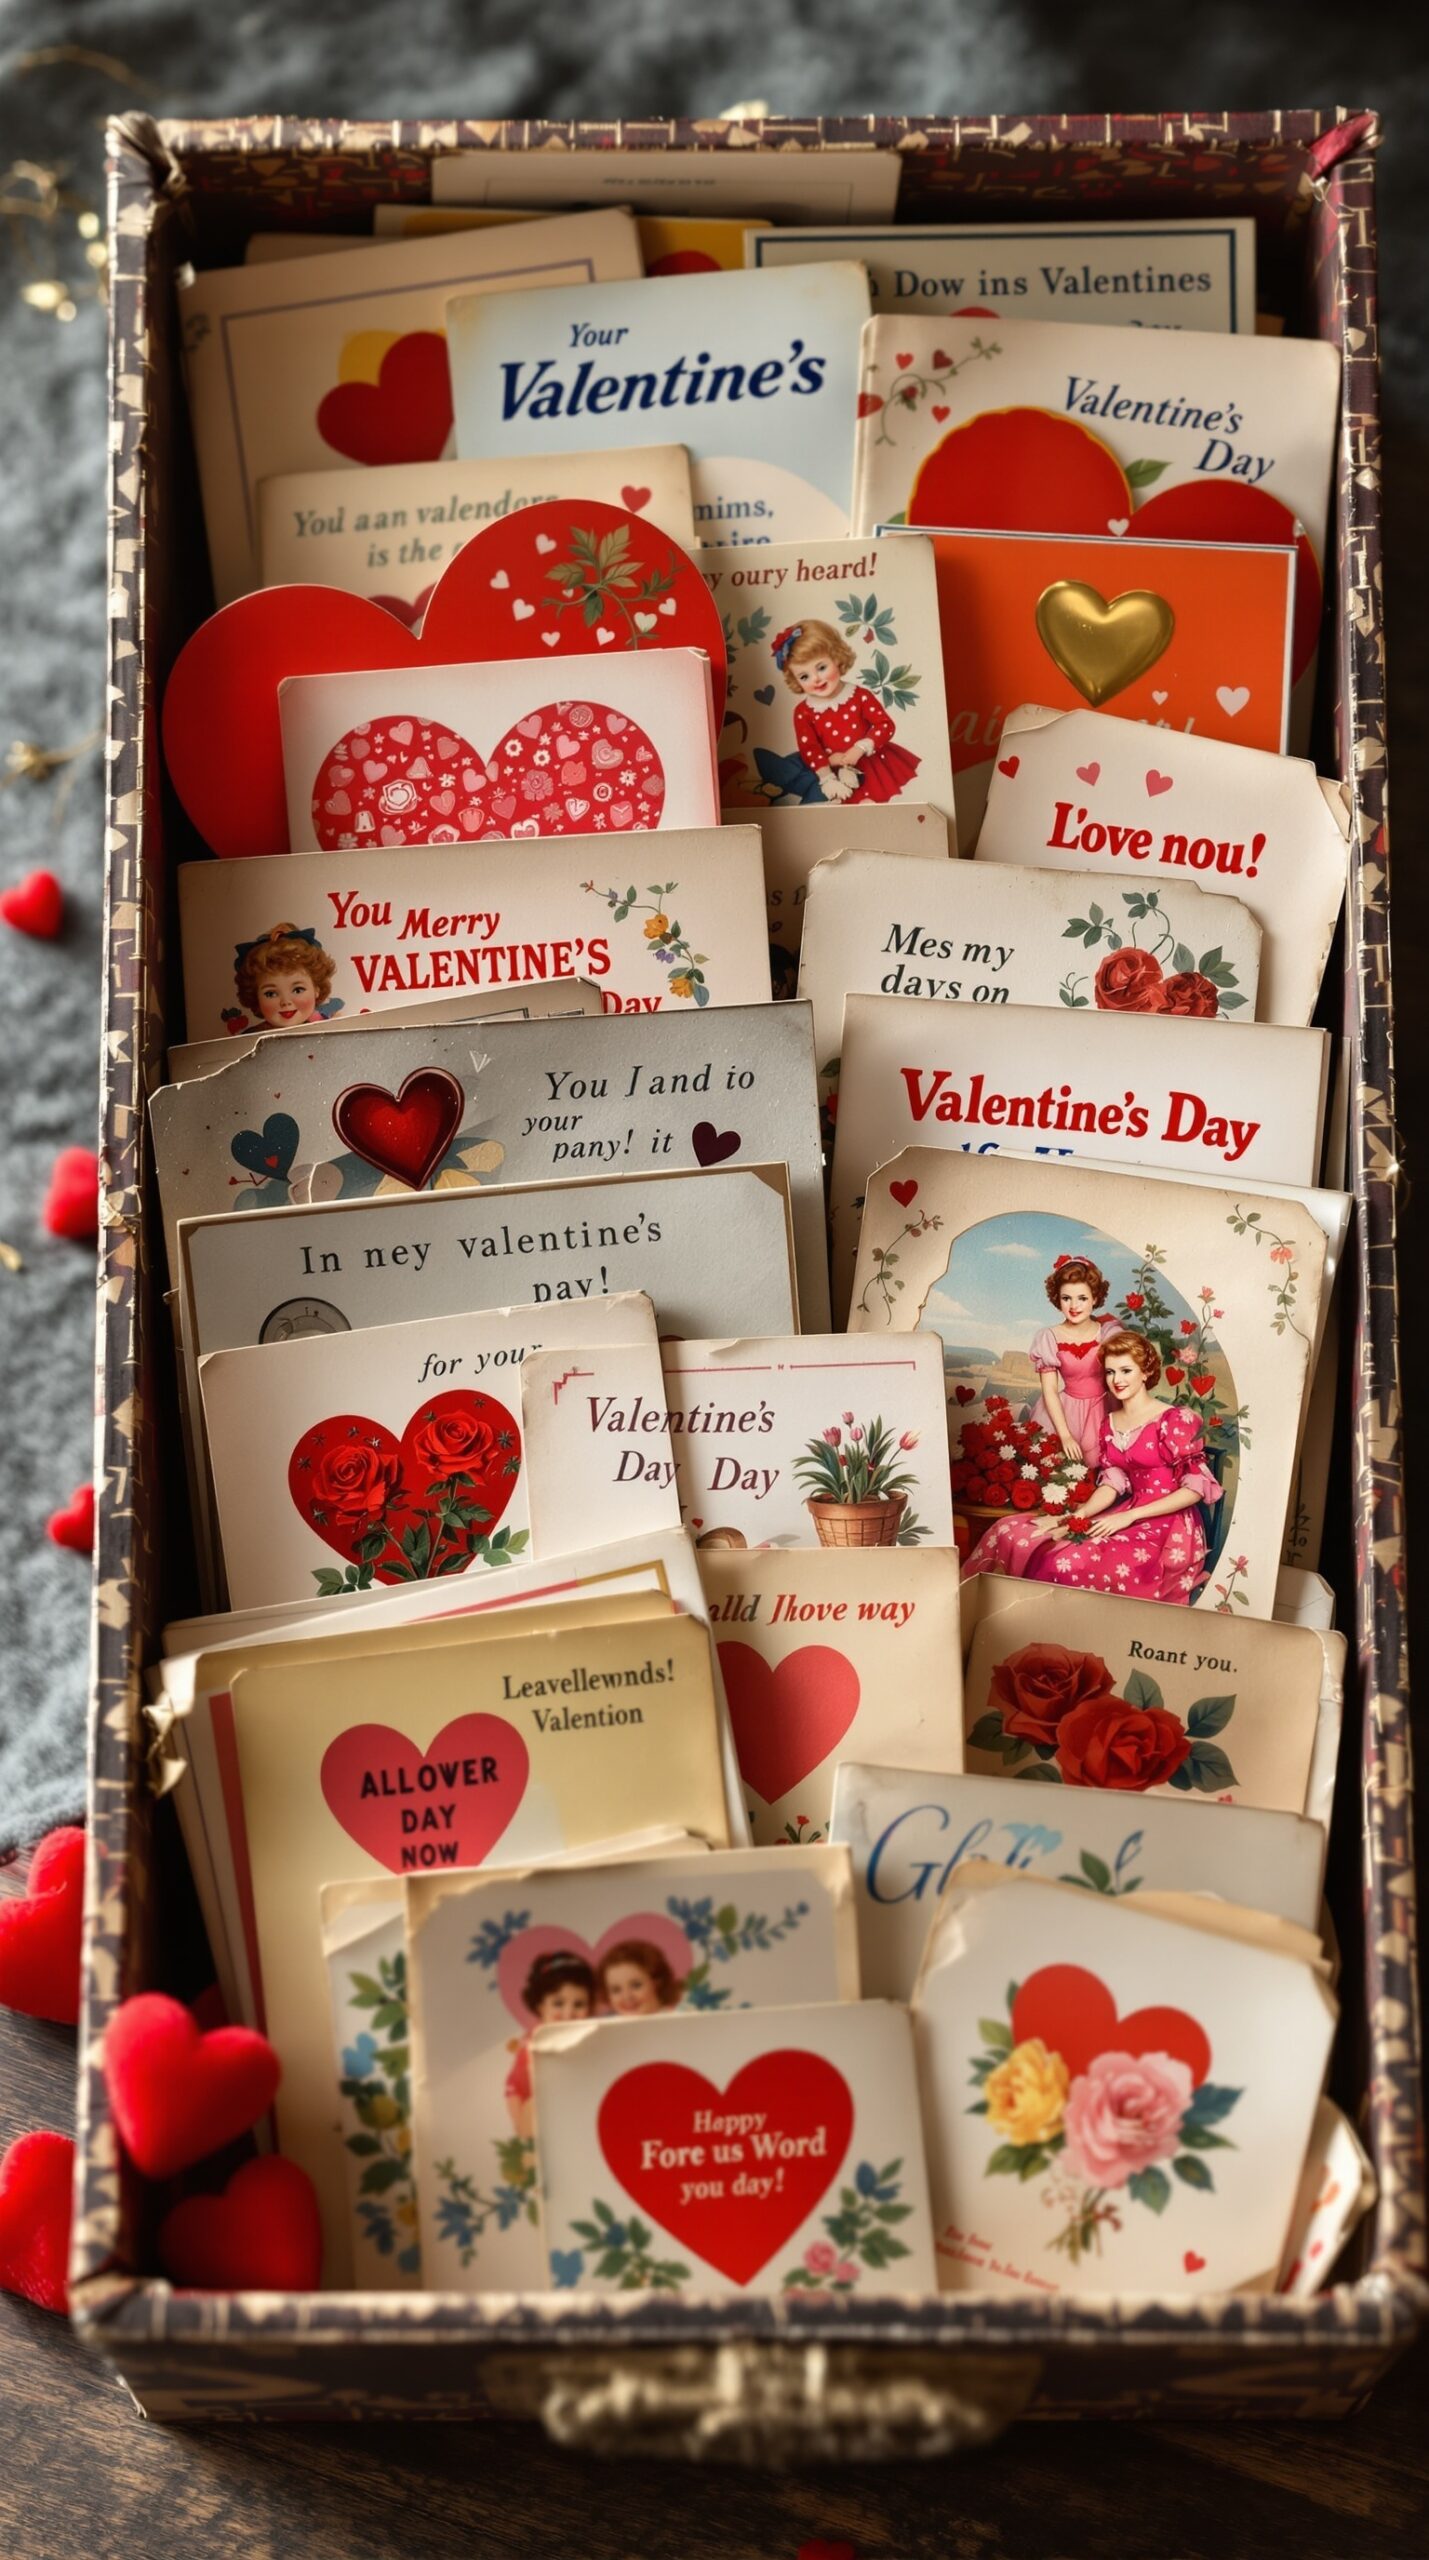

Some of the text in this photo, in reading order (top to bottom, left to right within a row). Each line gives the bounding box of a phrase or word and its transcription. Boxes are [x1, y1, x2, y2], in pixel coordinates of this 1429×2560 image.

[894, 270, 964, 297] Dow
[979, 269, 1028, 296] ins
[1040, 265, 1212, 296] Valentines
[569, 323, 628, 348] Your
[500, 340, 826, 421] Valentine's
[1065, 376, 1243, 435] Valentine's
[1193, 438, 1275, 486] Day
[367, 544, 389, 567] is
[398, 538, 443, 564] the
[731, 568, 789, 589] oury
[796, 552, 877, 582] heard!
[1159, 833, 1267, 879] nou!
[327, 890, 500, 941] You Merry
[350, 938, 611, 994] VALENTINE'S
[880, 923, 1015, 972] Mes my
[972, 985, 1010, 1004] on
[545, 1071, 608, 1100] You
[648, 1063, 712, 1095] and
[521, 1115, 583, 1136] your
[901, 1068, 1260, 1162] Valentine's Day
[552, 1129, 673, 1163] pany! it
[301, 1213, 662, 1274] In ney valentine's
[418, 1353, 462, 1383] for
[586, 1396, 775, 1434] Valentine's
[612, 1450, 780, 1500] Day Day
[857, 1600, 916, 1628] way
[1128, 1640, 1237, 1673] Roant you.
[532, 1704, 644, 1733] Valention
[360, 1756, 499, 1799] ALLOVER
[401, 1804, 456, 1834] DAY
[401, 1841, 459, 1869] NOW
[693, 2109, 767, 2136] Happy
[640, 2125, 827, 2170] Fore us Word
[680, 2166, 785, 2206] you day!
